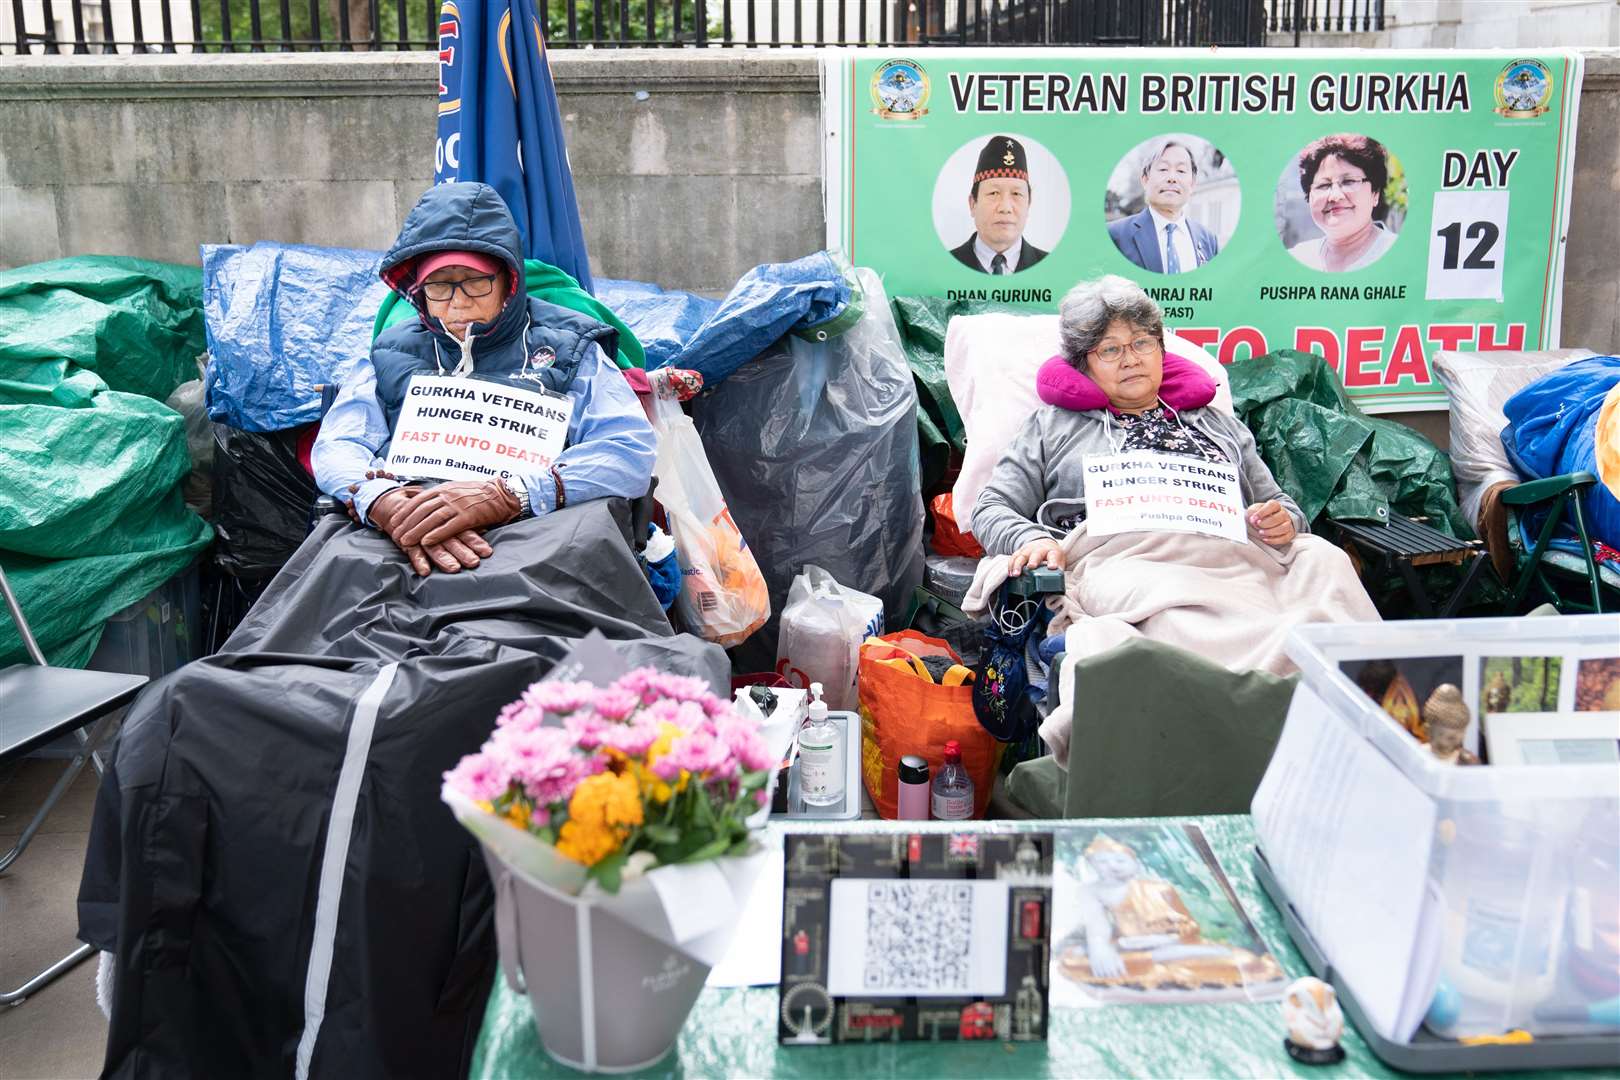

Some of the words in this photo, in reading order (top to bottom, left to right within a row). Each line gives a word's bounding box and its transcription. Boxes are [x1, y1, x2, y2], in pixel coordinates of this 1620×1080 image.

[949, 74, 1127, 113] VETERAN
[1141, 74, 1296, 113] BRITISH
[1309, 73, 1470, 113] GURKHA
[1443, 150, 1519, 188] DAY
[1437, 221, 1499, 270] 12
[947, 289, 987, 301] DHAN
[991, 288, 1052, 303] GURUNG
[1189, 287, 1213, 301] RAI
[1260, 286, 1316, 300] PUSHPA
[1320, 286, 1360, 300] RANA
[1363, 285, 1407, 300] GHALE
[1164, 306, 1195, 320] FAST)
[411, 385, 476, 401] GURKHA
[482, 392, 567, 423] VETERANS
[416, 407, 484, 424] HUNGER
[488, 416, 549, 440] STRIKE
[401, 431, 441, 443] FAST
[445, 433, 491, 451] UNTO
[496, 443, 551, 467] DEATH
[391, 454, 410, 465] (Mr
[413, 455, 442, 466] Dhan
[445, 458, 497, 476] Bahadur
[1088, 461, 1154, 474] GURKHA
[1158, 461, 1236, 483] VETERANS
[1102, 476, 1168, 488] HUNGER
[1172, 478, 1227, 495] STRIKE
[1095, 495, 1134, 508] FAST
[1140, 495, 1183, 504] UNTO
[1188, 498, 1238, 515] DEATH
[1186, 514, 1223, 529] Ghale)
